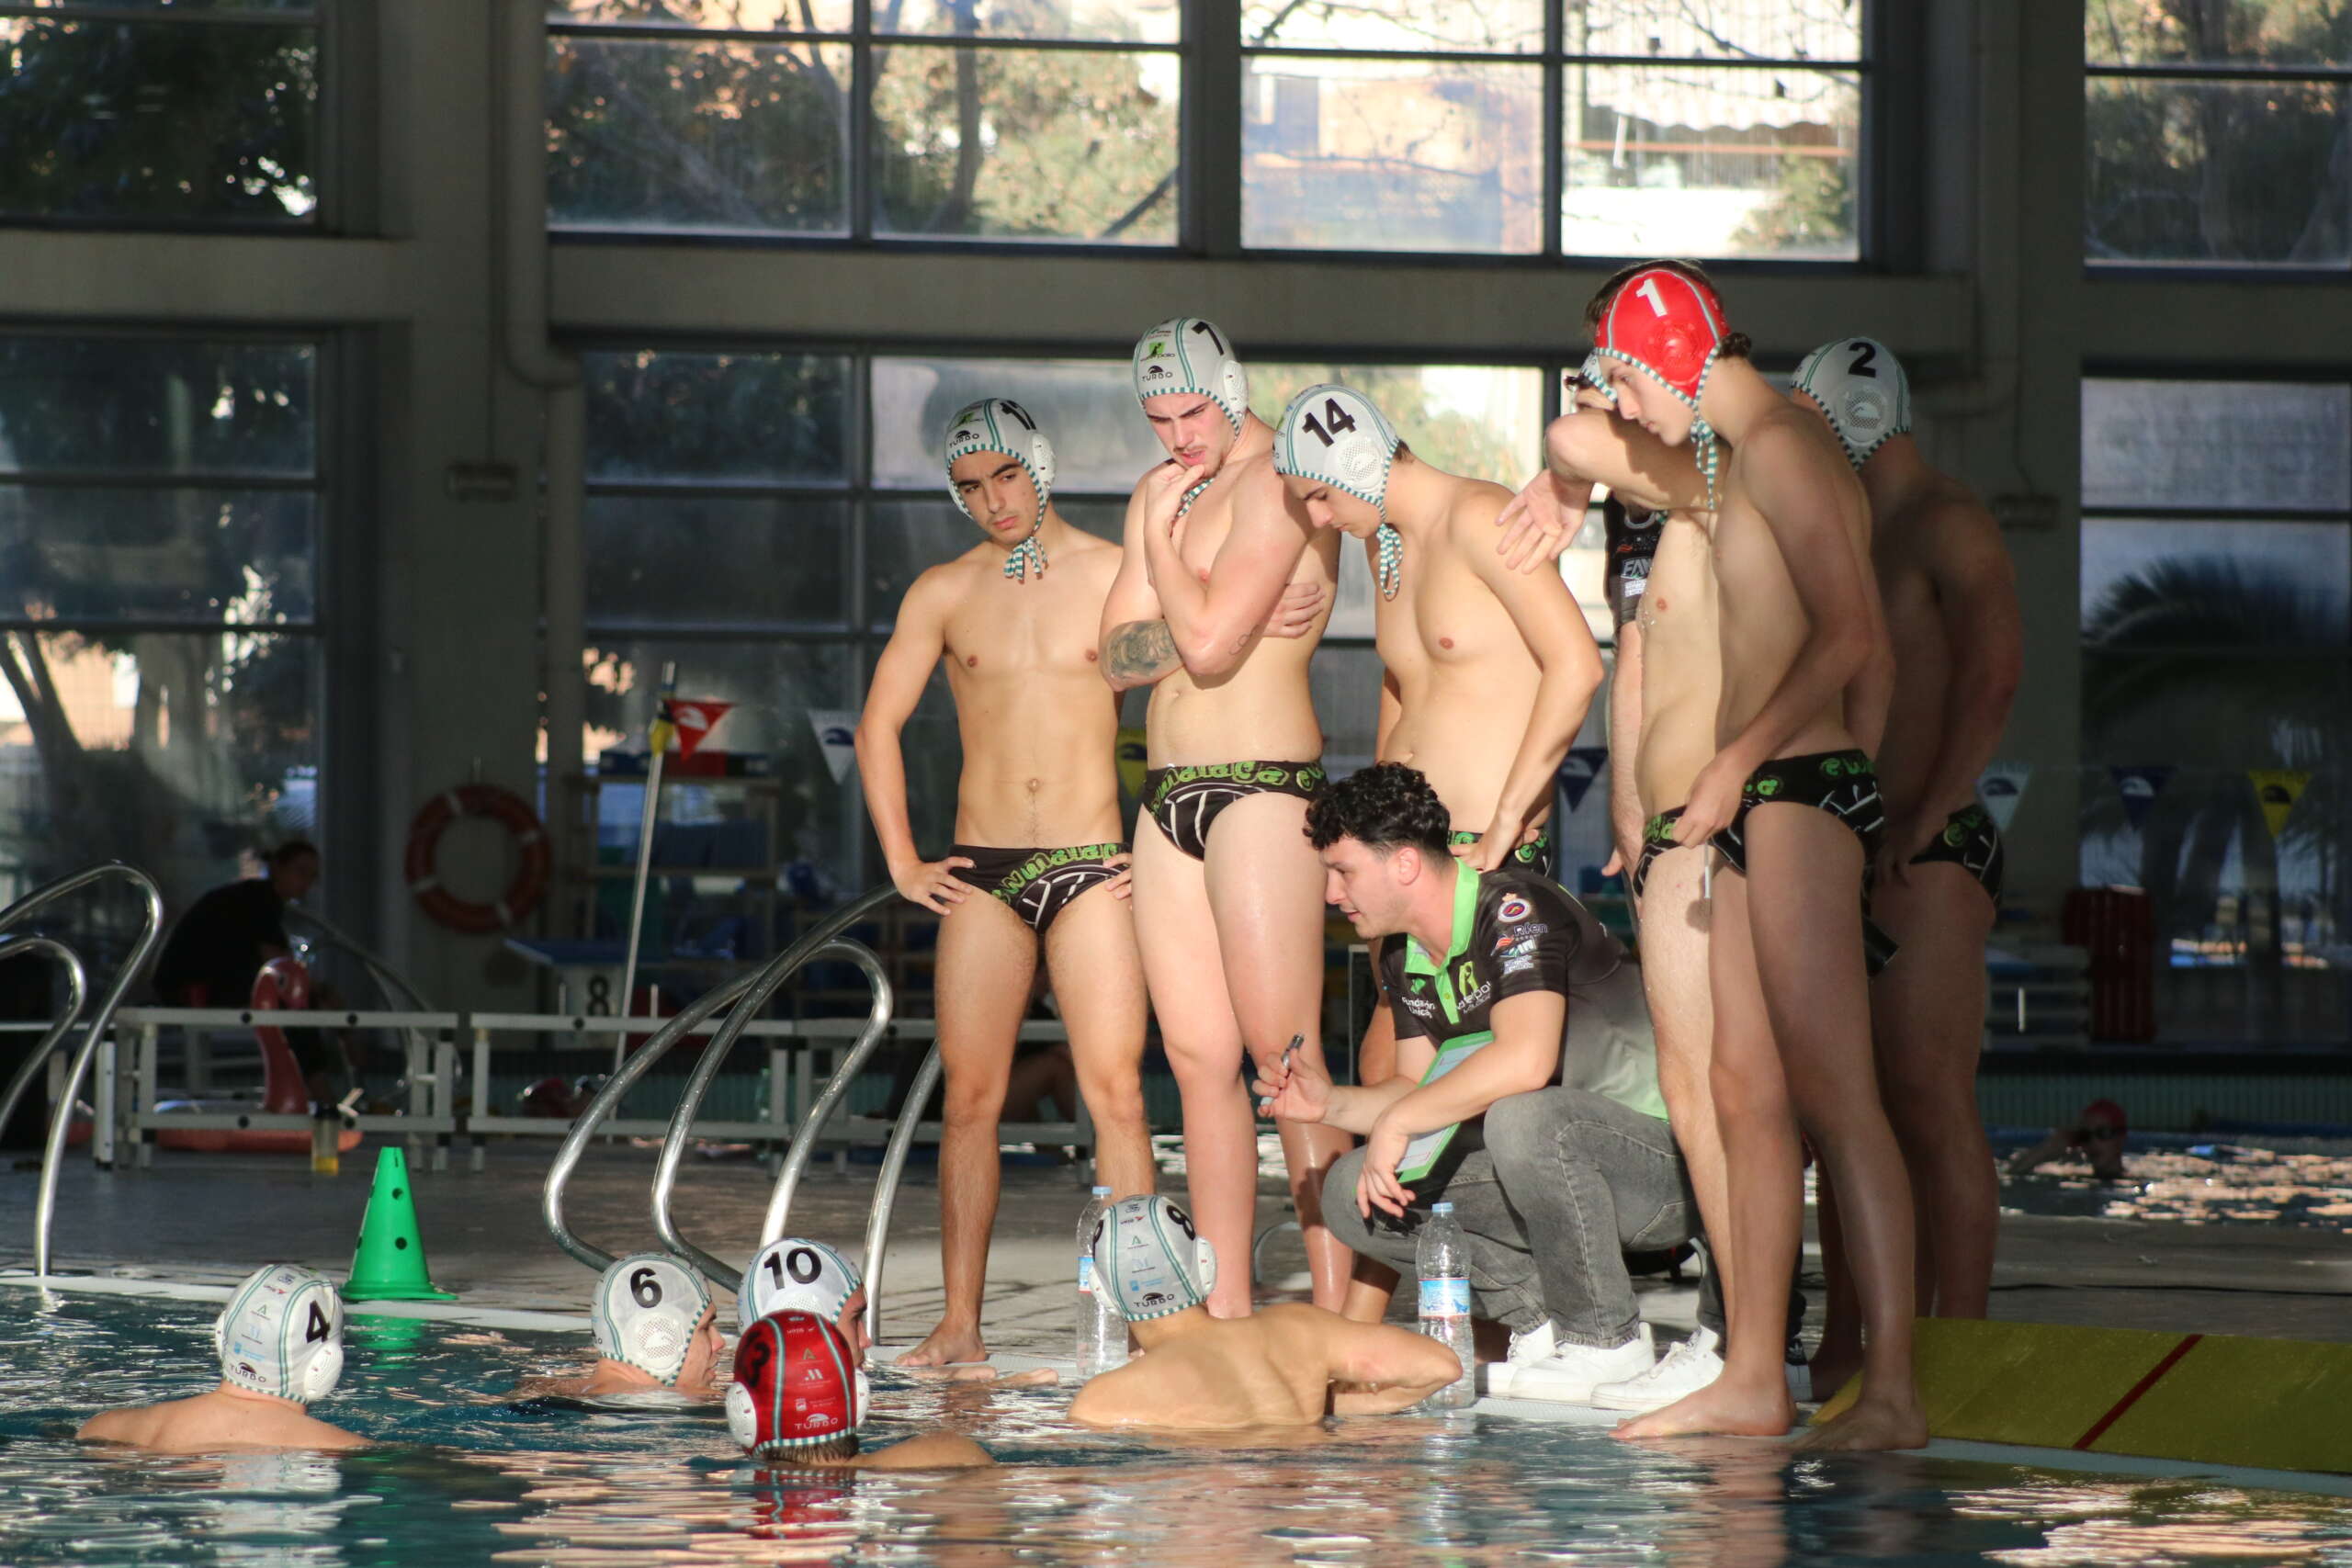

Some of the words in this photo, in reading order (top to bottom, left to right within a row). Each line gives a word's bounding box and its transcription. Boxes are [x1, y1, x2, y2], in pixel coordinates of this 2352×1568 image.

[1635, 278, 1668, 318] 1
[1142, 371, 1173, 383] TURBO
[1848, 342, 1877, 378] 2
[1302, 398, 1357, 447] 14
[630, 1267, 663, 1309] 6
[763, 1247, 822, 1291] 10
[1134, 1293, 1175, 1308] TURBO
[306, 1300, 330, 1344] 4
[229, 1362, 267, 1383] TURBO
[794, 1417, 839, 1431] TURBO
